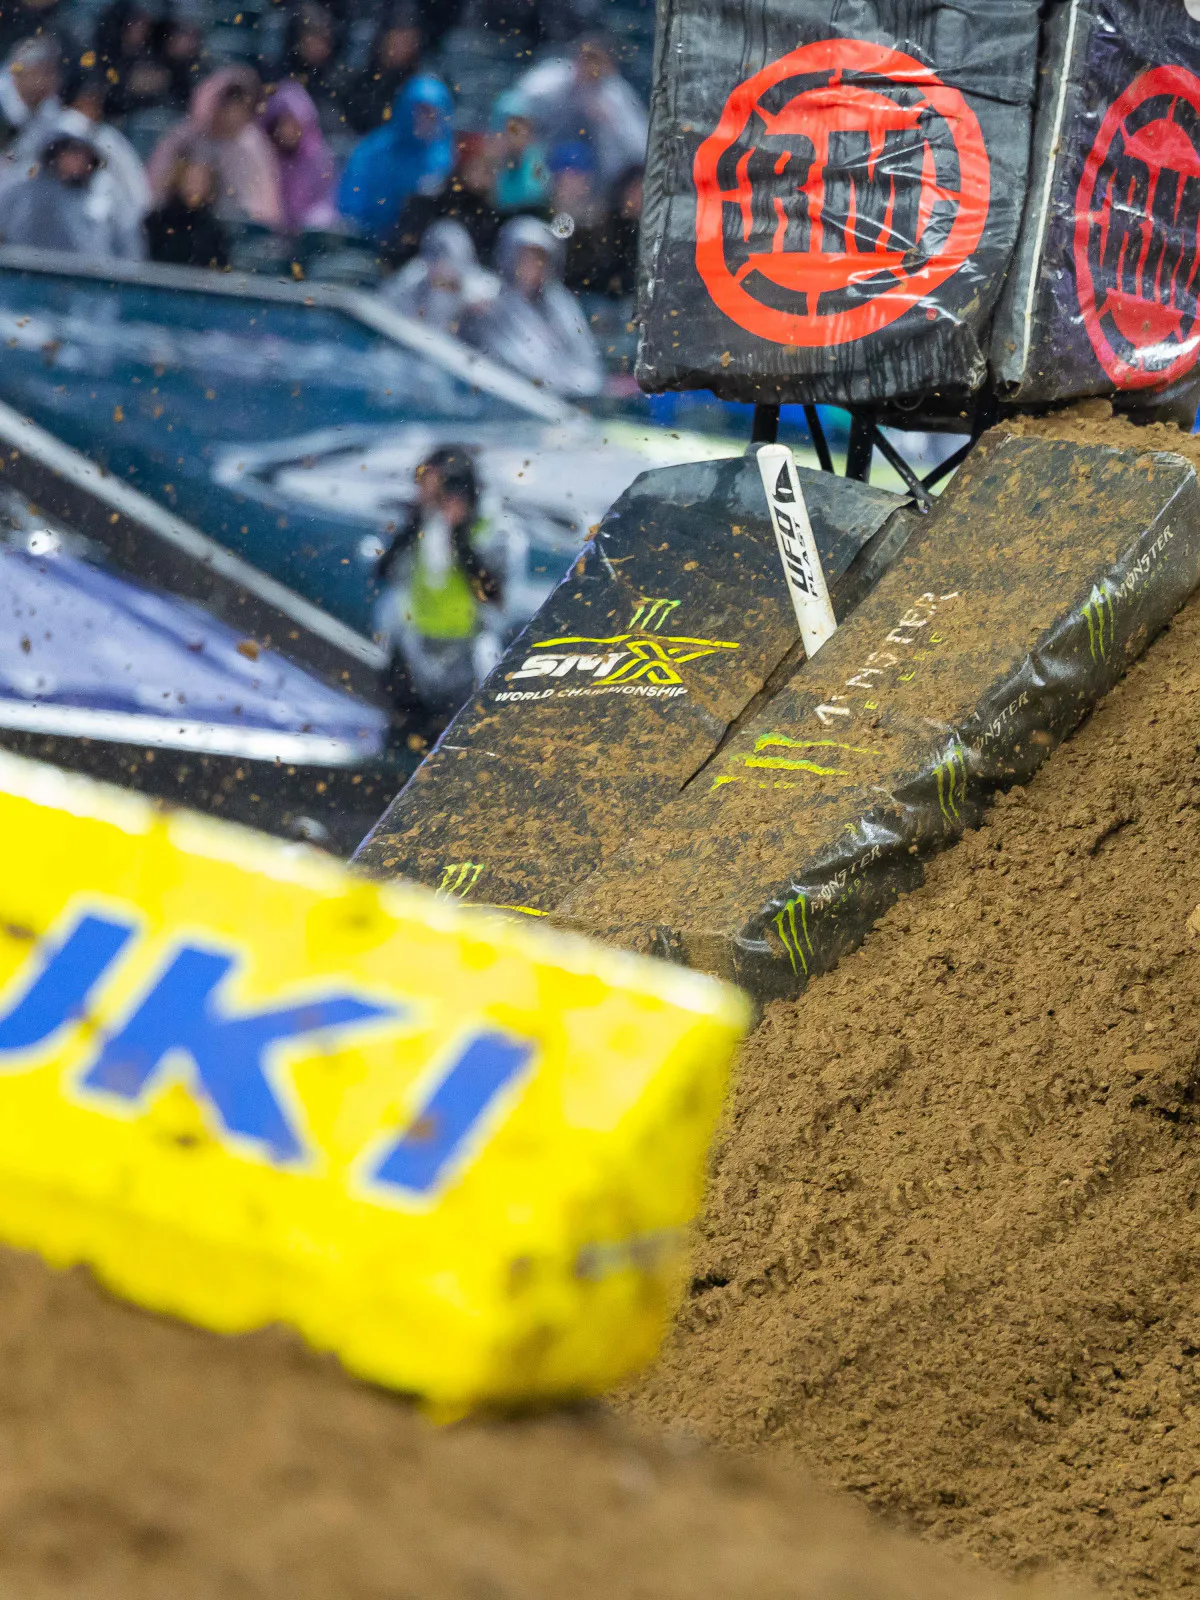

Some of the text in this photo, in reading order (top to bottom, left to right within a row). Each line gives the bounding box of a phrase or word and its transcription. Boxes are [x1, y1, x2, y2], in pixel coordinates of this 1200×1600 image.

[773, 505, 810, 594] UFO
[1114, 524, 1174, 605] MONSTER
[495, 685, 688, 702] WORLD CHAMPIONSHIP
[512, 641, 717, 686] SMX
[810, 844, 882, 915] MONSTER
